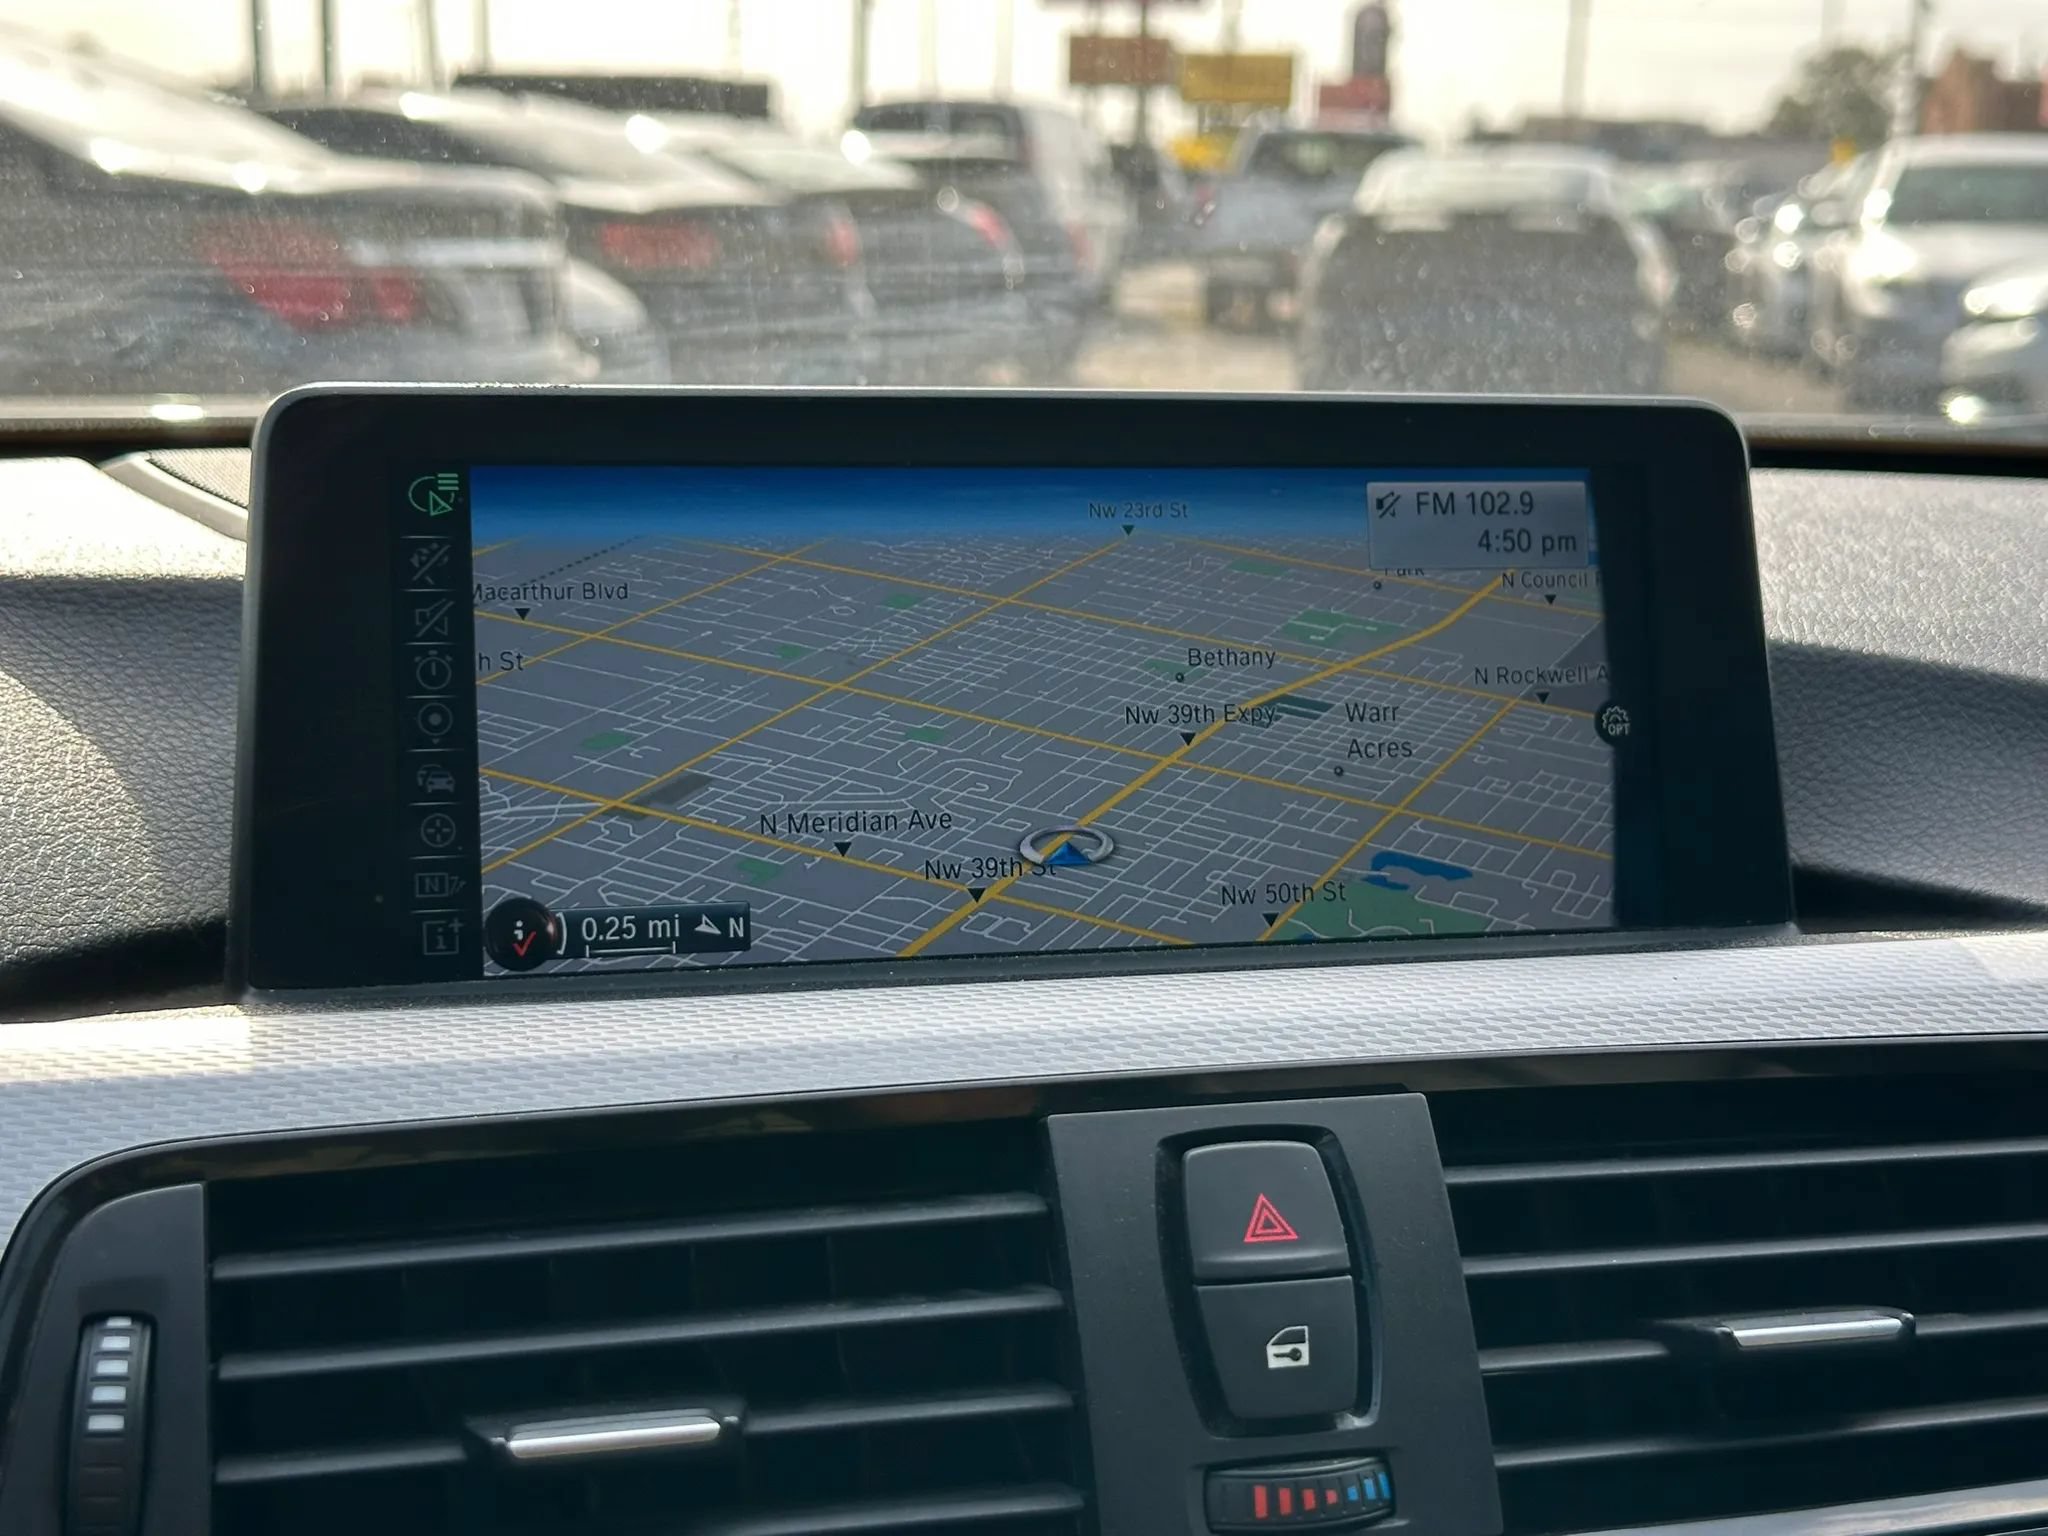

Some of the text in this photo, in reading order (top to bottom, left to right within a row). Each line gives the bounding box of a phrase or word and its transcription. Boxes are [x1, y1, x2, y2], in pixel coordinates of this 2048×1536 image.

[1088, 501, 1188, 519] Nw 23rd St
[1415, 490, 1534, 516] FM 102.9
[1477, 527, 1577, 557] 4:50 pm
[1501, 571, 1515, 588] N
[1520, 570, 1588, 588] Council
[582, 582, 629, 600] Blvd
[500, 651, 524, 671] St
[1187, 647, 1277, 670] Bethany
[1474, 666, 1489, 685] N
[1496, 664, 1588, 685] Rockwell
[1124, 703, 1277, 726] Nw 39th Expy
[1344, 701, 1400, 723] Warr
[1607, 722, 1630, 737] OPT
[1346, 738, 1413, 759] Acres
[759, 808, 953, 835] N Meridian Ave
[924, 859, 962, 881] Nw
[970, 855, 1024, 880] 39th
[1221, 880, 1347, 905] Nw 50th St
[581, 913, 745, 941] 0.25 mi N
